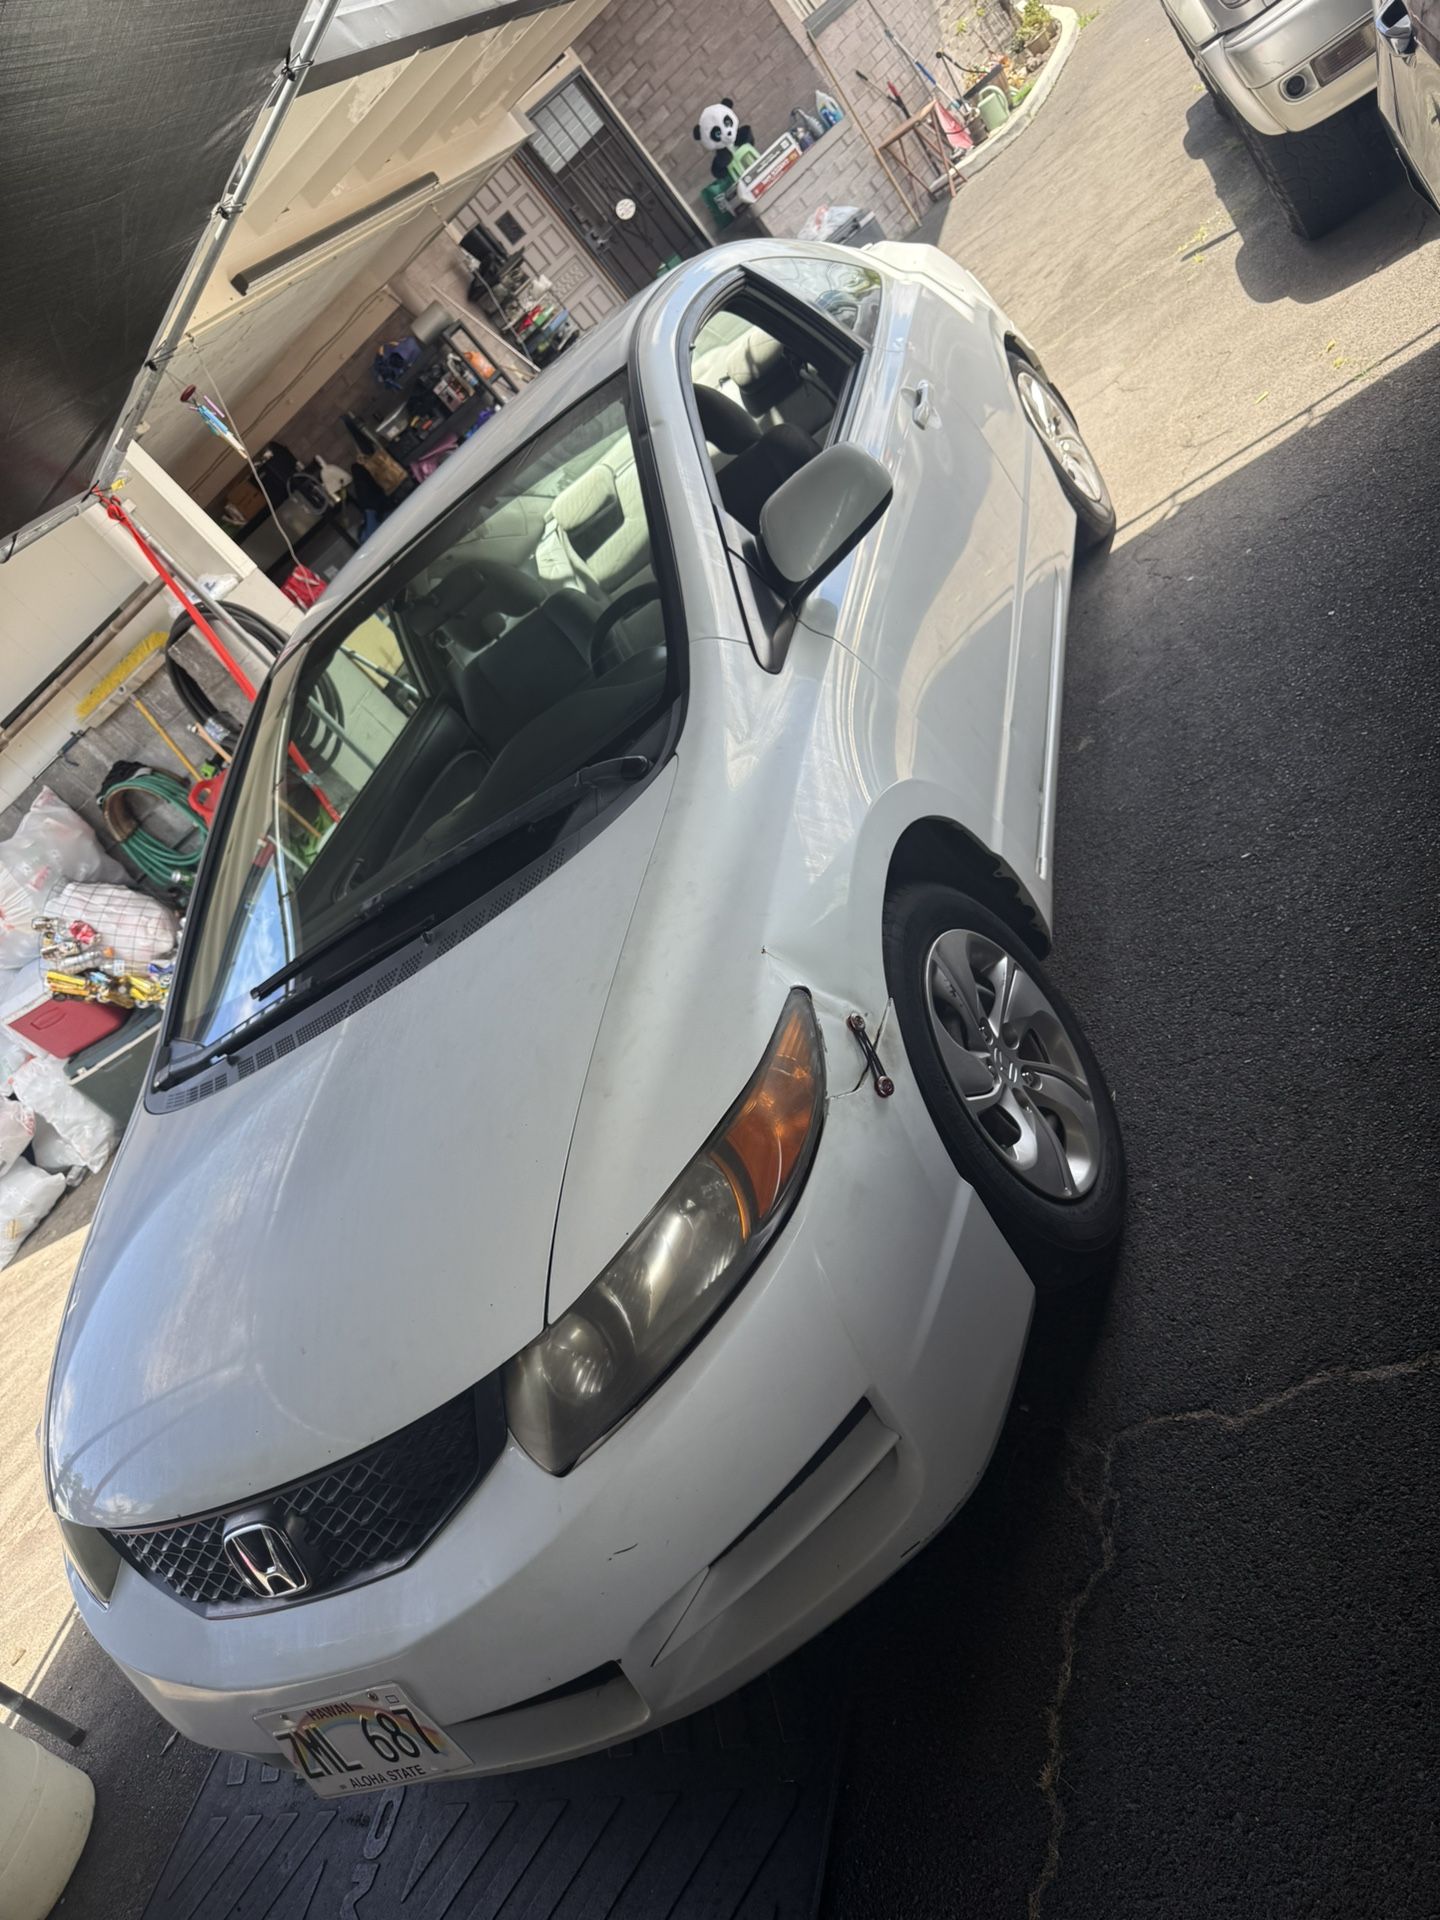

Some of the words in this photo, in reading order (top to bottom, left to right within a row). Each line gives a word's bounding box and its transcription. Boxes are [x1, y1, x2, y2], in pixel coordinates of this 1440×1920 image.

[306, 1702, 355, 1721] HAWAII
[273, 1724, 364, 1779] ZML
[359, 1705, 440, 1763] 687
[350, 1771, 388, 1789] ALOHA
[385, 1764, 426, 1782] STATE
